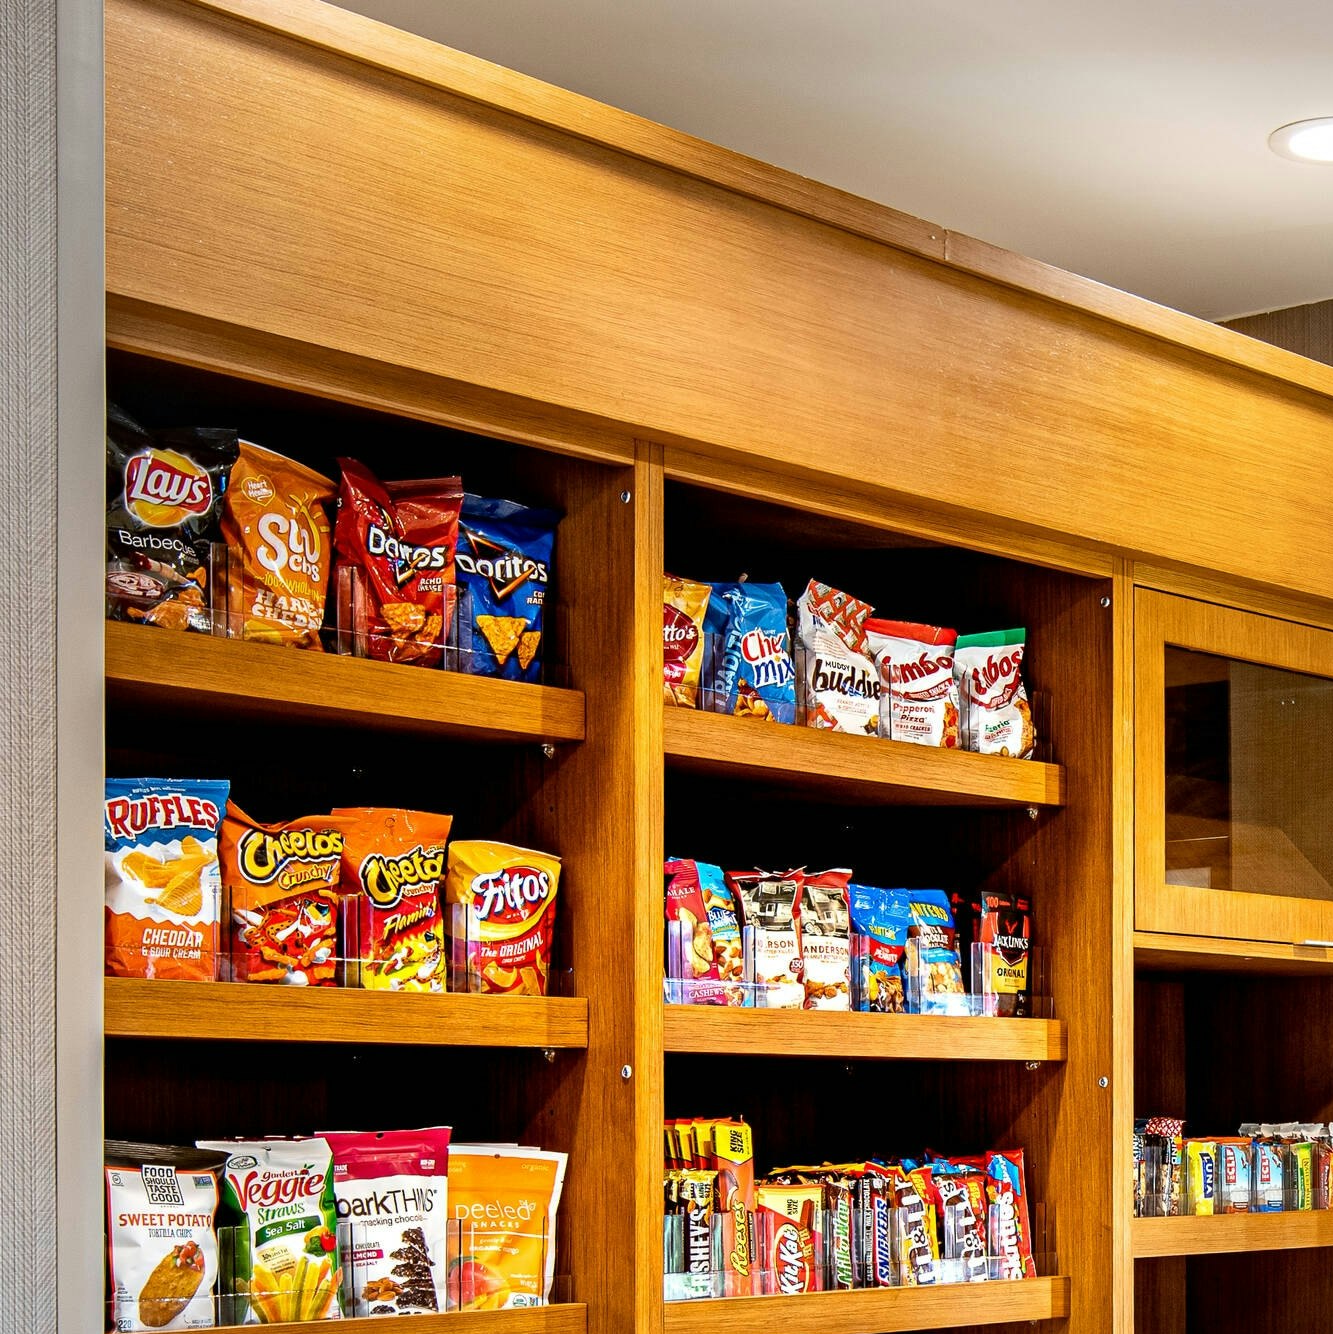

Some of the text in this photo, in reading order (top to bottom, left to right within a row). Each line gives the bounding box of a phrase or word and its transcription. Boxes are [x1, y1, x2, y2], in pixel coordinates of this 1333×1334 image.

[130, 459, 207, 506] Lay's
[455, 554, 547, 582] Doritos
[755, 656, 796, 687] mix
[825, 660, 851, 671] MUDDY
[901, 714, 927, 723] Pizza
[107, 795, 219, 838] RUFFLES
[241, 831, 343, 878] Cheetos
[279, 863, 332, 888] Crunchy
[472, 868, 549, 920] Fritos
[142, 928, 203, 947] CHEDDAR
[480, 932, 543, 957] The ORIGINAL
[996, 967, 1025, 979] ORIGINAL
[730, 1130, 738, 1152] KING
[144, 1167, 173, 1177] FOOD
[146, 1178, 176, 1186] SHOULD
[1202, 1155, 1213, 1198] LUNA
[149, 1186, 178, 1194] TASTE
[151, 1194, 181, 1203] GOOD
[229, 1173, 326, 1213] Veggie
[118, 1213, 212, 1227] SWEET POTATO
[257, 1201, 305, 1224] Straws
[148, 1227, 193, 1239] TORTILLA CHIPS
[265, 1221, 306, 1238] Sea Salt
[472, 1221, 520, 1229] SNACKS
[730, 1201, 749, 1276] Reese's
[876, 1200, 889, 1281] SNICKERS
[779, 1227, 804, 1294] KitKat
